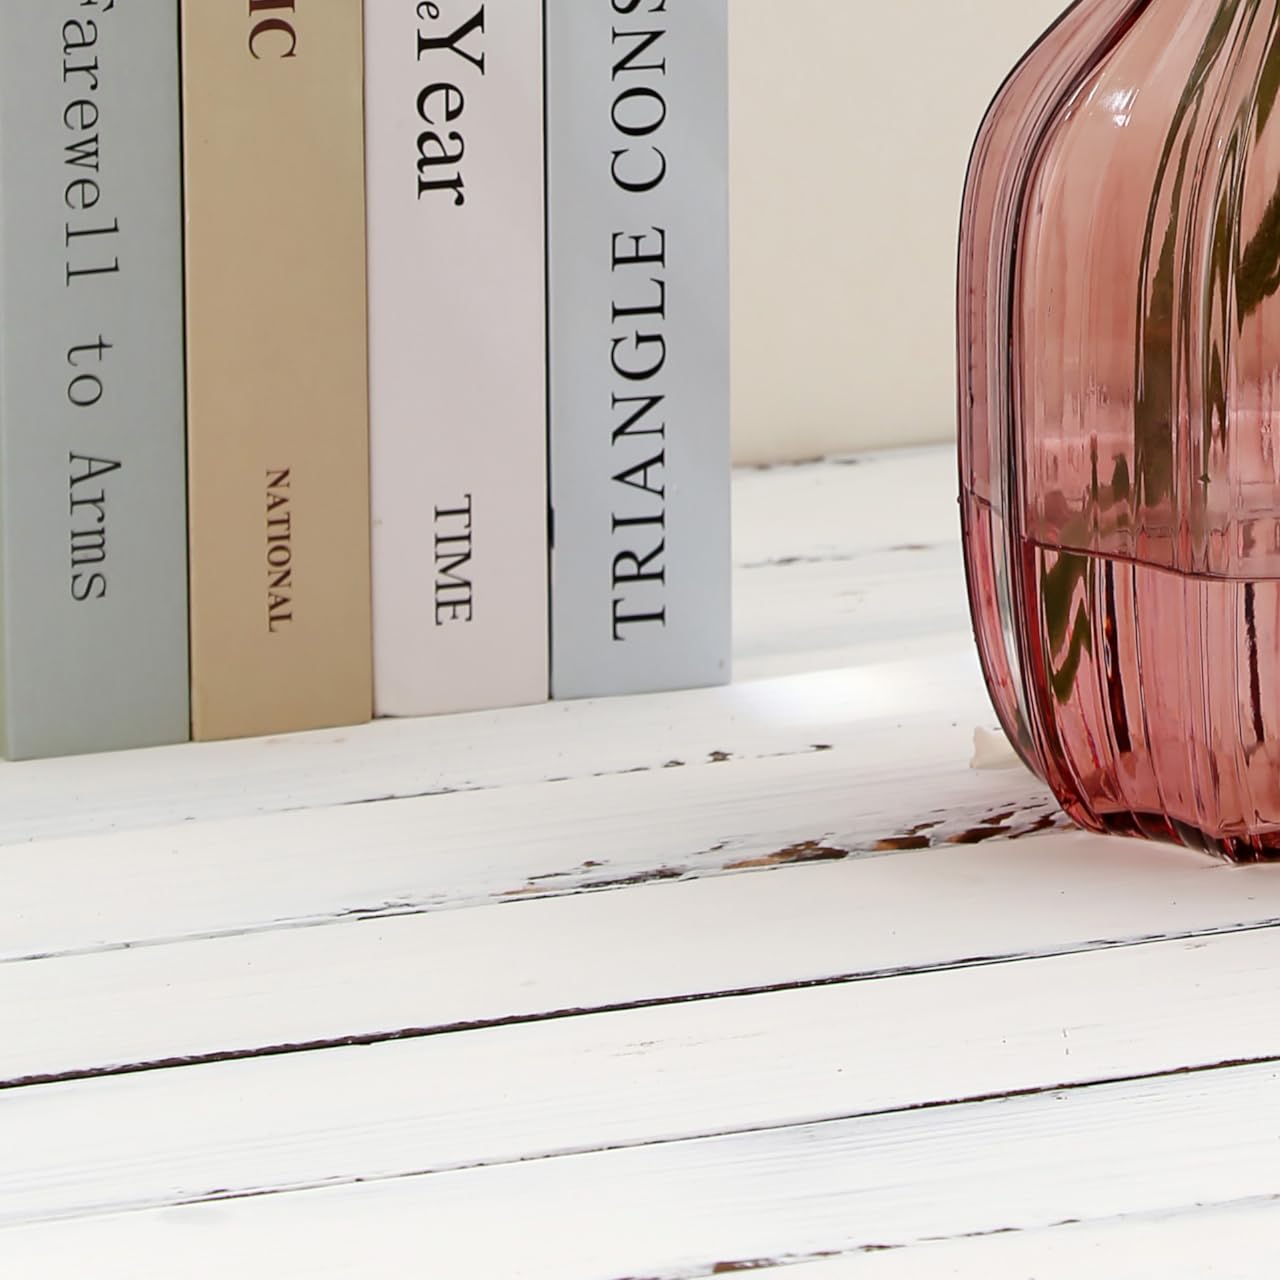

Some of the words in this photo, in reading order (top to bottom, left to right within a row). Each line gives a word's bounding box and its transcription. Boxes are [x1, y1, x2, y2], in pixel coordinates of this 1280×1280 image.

[416, 3, 485, 206] Year
[67, 334, 113, 408] to
[611, 226, 667, 641] TRIANGLE
[69, 451, 122, 601] Arms
[266, 468, 293, 632] NATIONAL
[434, 493, 473, 626] TIME
